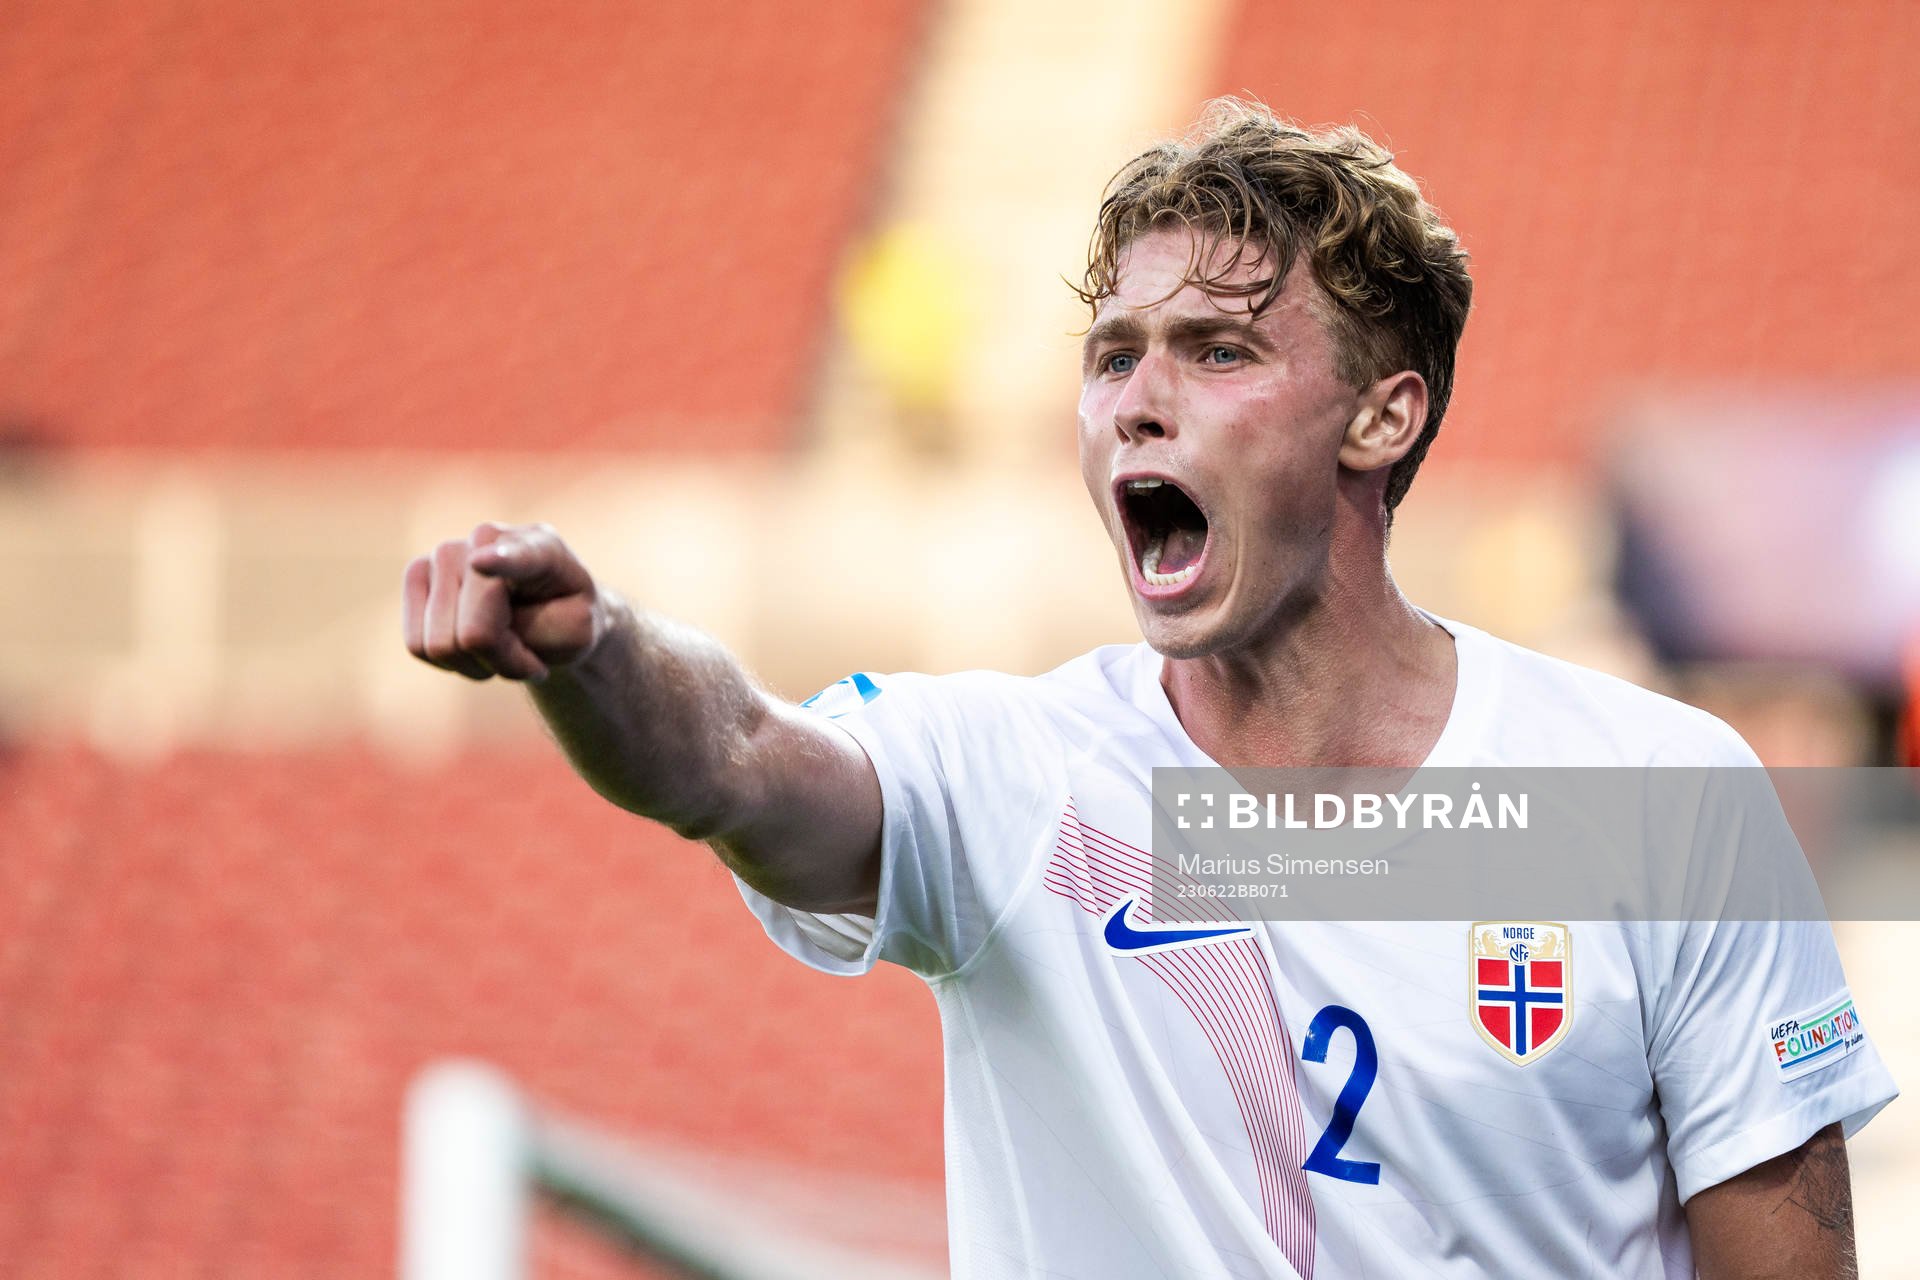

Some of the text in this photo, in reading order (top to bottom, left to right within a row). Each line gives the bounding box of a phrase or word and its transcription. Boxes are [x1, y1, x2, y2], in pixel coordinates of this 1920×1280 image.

[1503, 927, 1535, 940] NORGE
[1771, 1020, 1799, 1040] UEFA
[1774, 1006, 1859, 1062] FOUNDATION
[1301, 1004, 1381, 1186] 2
